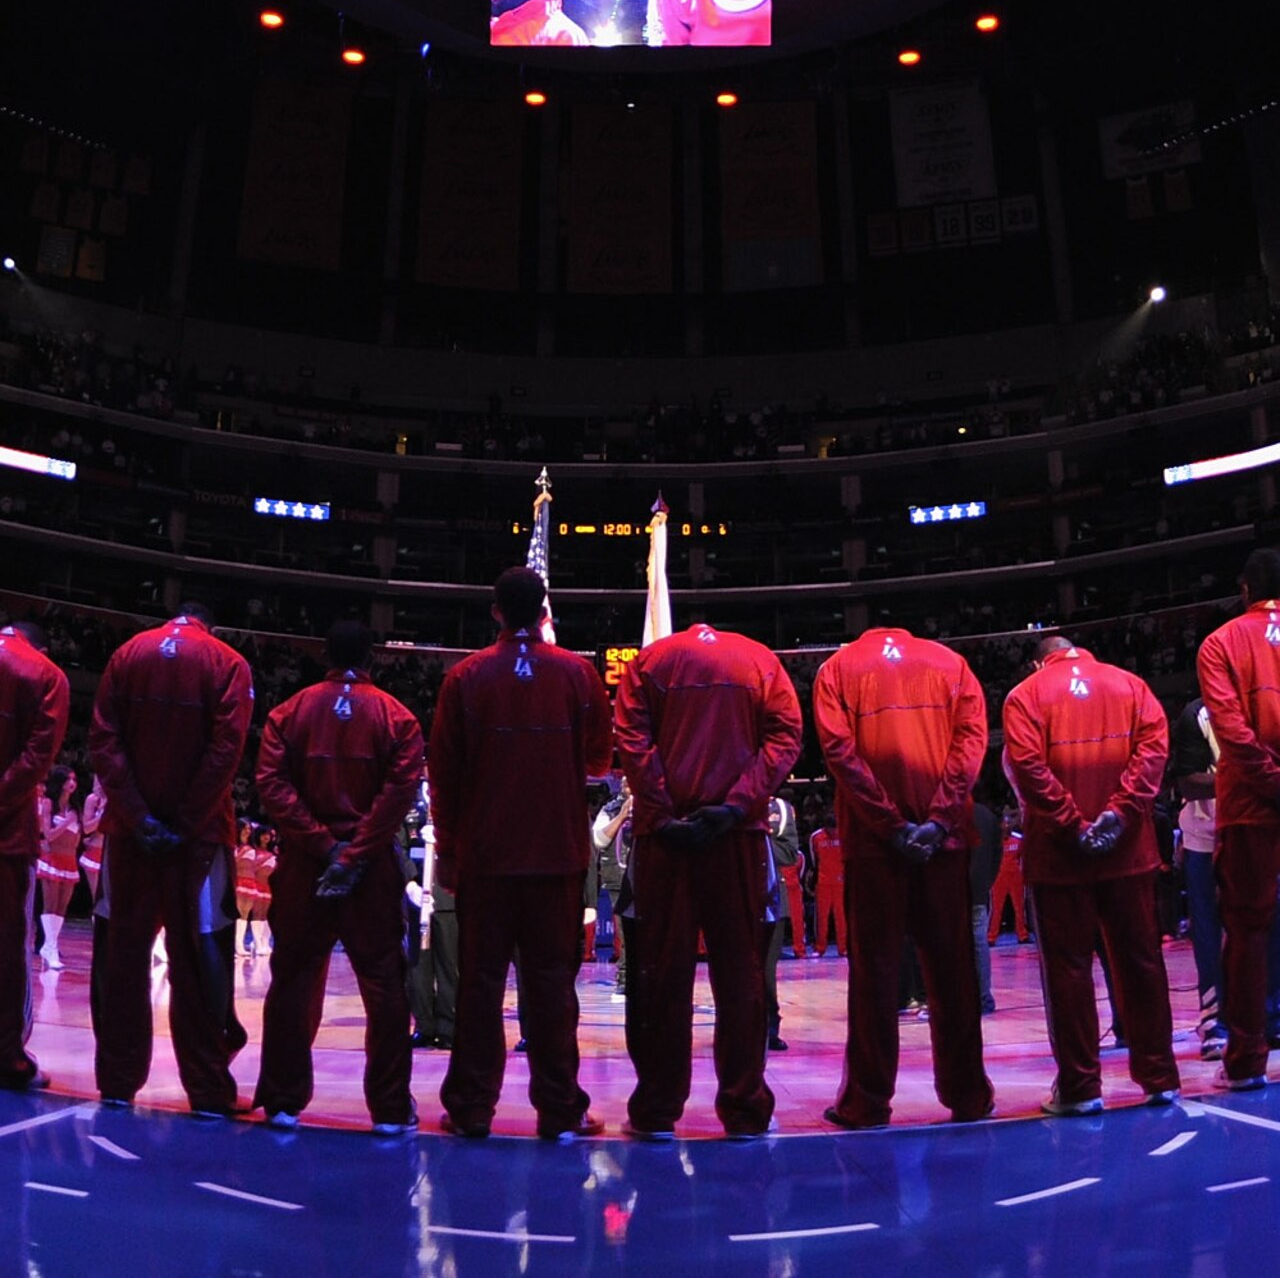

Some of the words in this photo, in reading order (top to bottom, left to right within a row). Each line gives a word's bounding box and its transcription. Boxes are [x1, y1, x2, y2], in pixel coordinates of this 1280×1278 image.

[514, 657, 533, 676] LA
[1070, 678, 1089, 695] LA
[333, 696, 352, 715] LA
